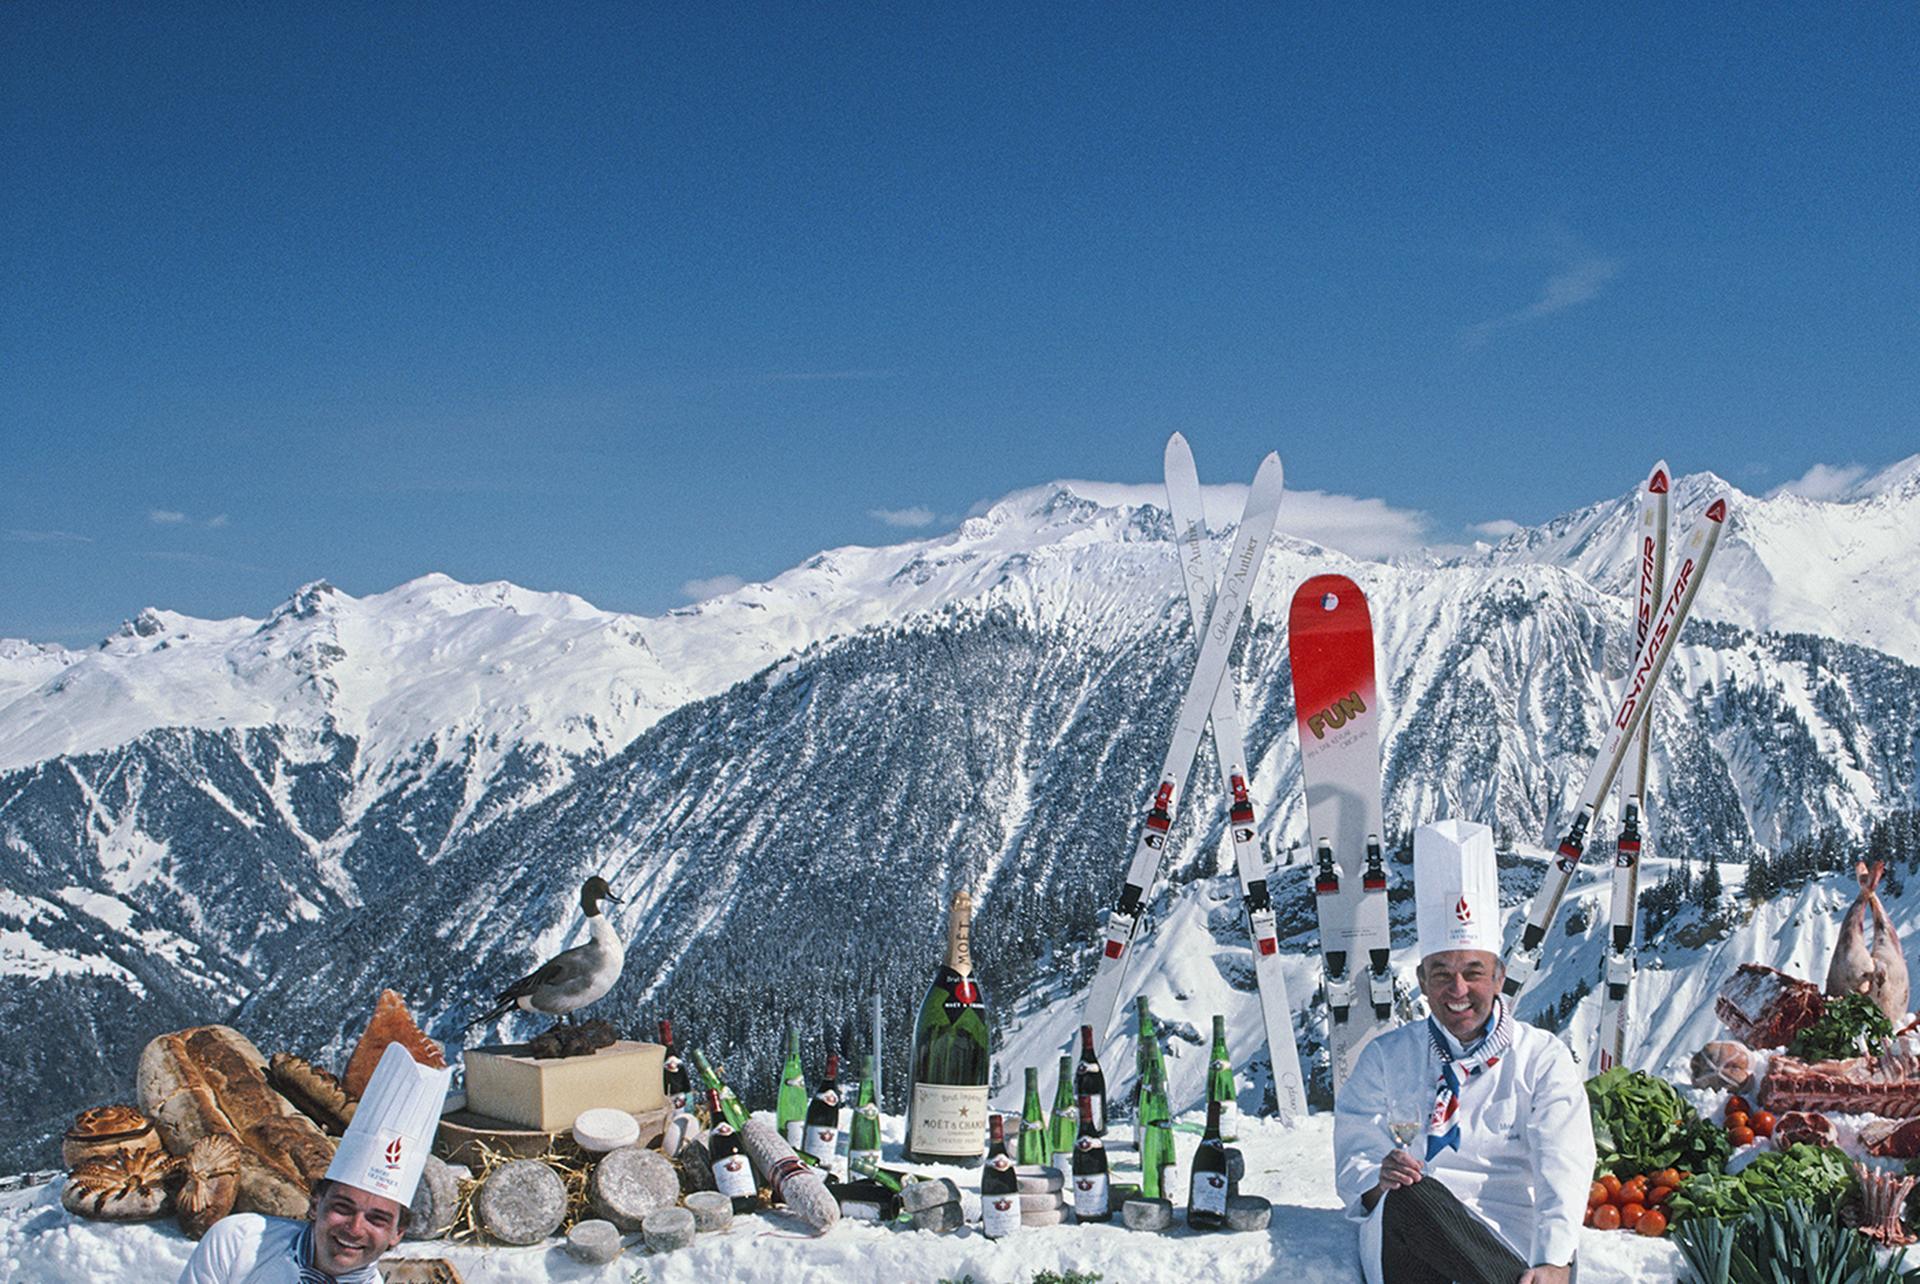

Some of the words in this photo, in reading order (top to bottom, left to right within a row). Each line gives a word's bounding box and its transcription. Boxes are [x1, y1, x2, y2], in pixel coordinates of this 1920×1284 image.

[1234, 536, 1258, 583] Authier
[1615, 558, 1696, 731] DYNASTAR
[1307, 690, 1367, 740] FUN
